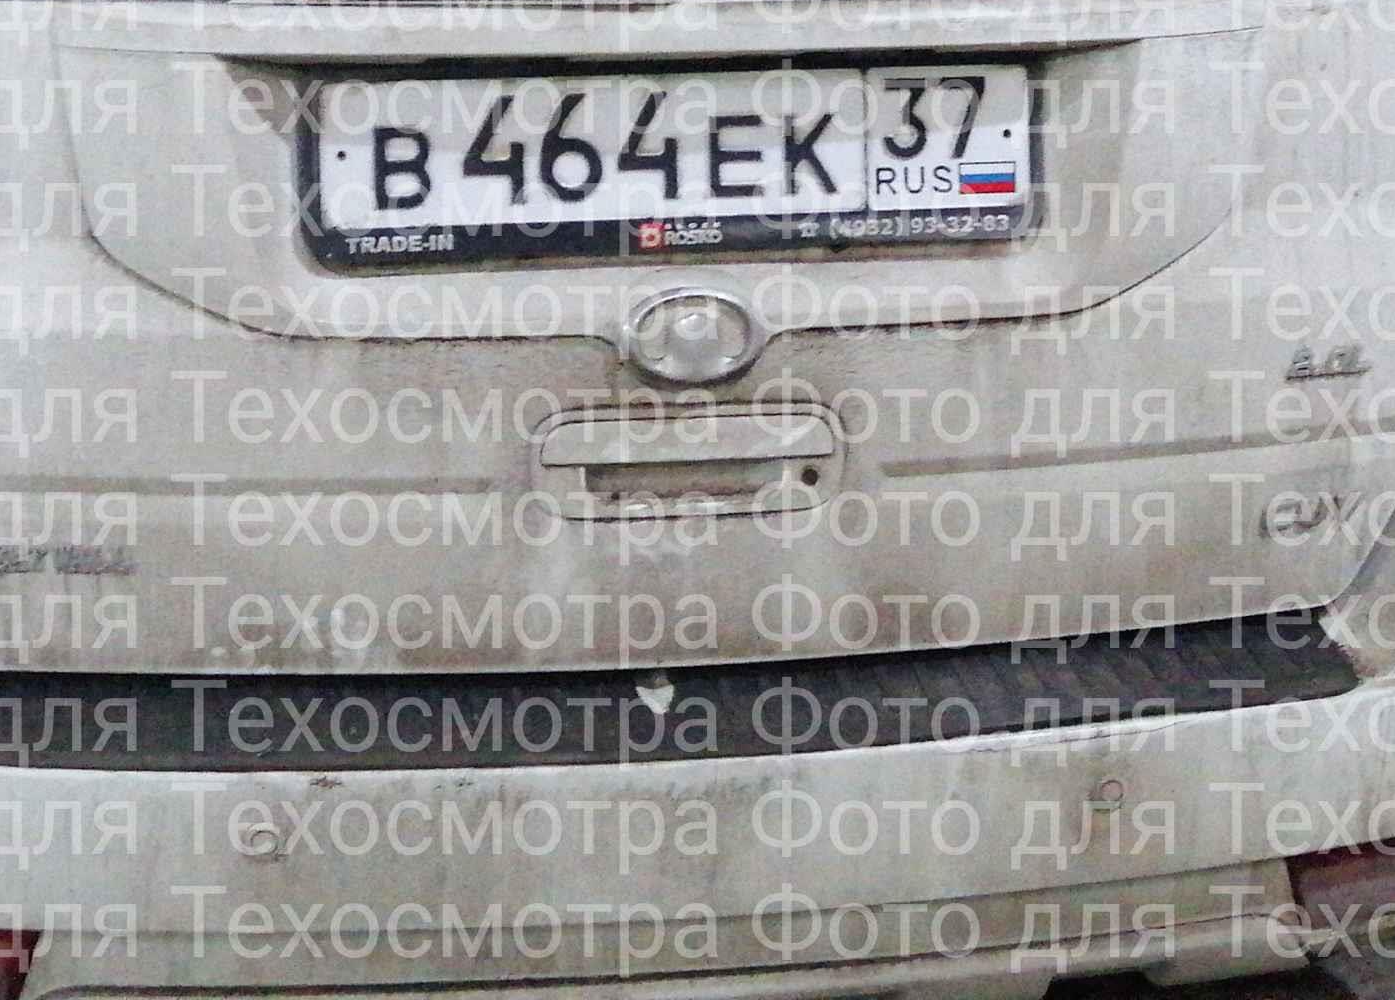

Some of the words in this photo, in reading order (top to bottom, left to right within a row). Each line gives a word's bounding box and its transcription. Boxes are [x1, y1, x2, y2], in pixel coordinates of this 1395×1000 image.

[882, 75, 986, 159] 37
[874, 164, 953, 195] RUS
[910, 213, 1010, 235] 93-32-83
[345, 233, 455, 253] TRADE-IN
